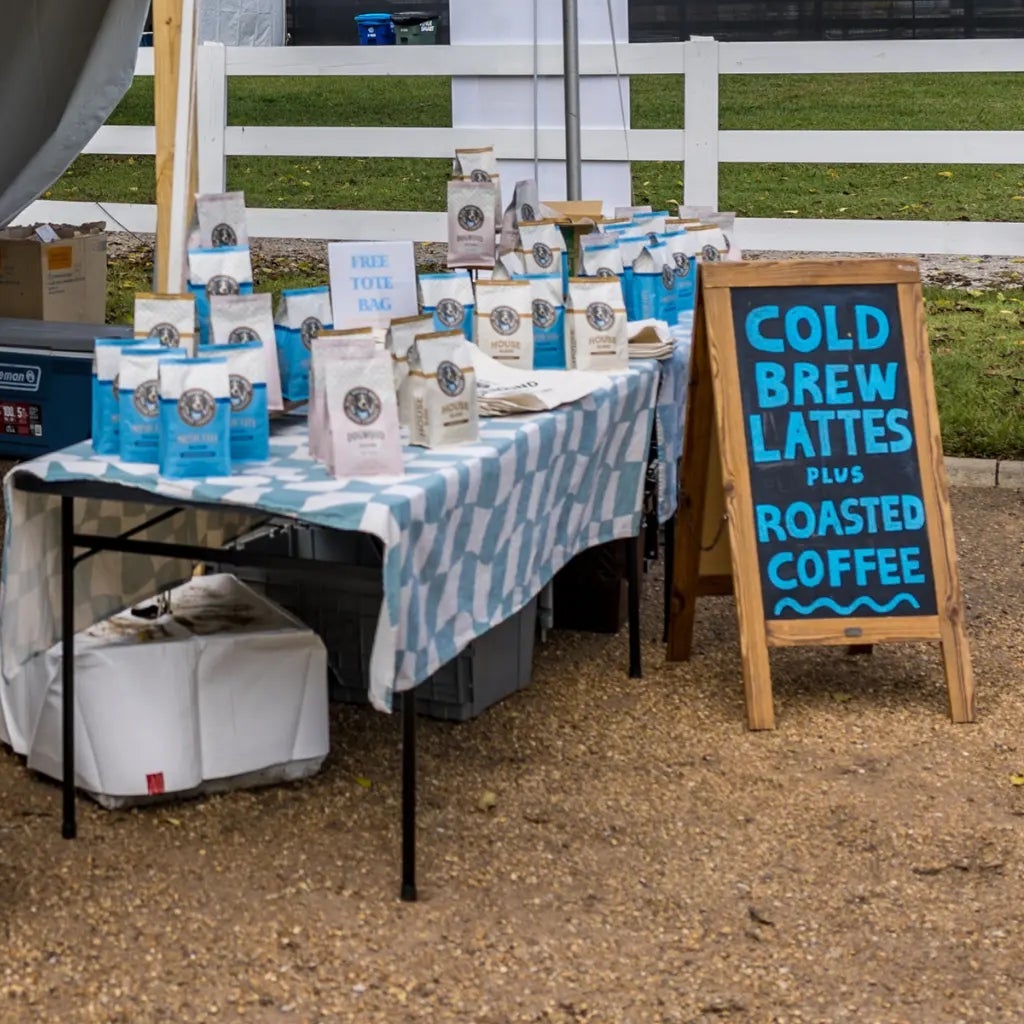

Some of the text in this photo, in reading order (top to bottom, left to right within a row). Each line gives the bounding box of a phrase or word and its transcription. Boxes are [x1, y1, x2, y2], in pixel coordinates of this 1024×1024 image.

[350, 254, 390, 269] FREE
[349, 275, 394, 290] TOTE
[358, 297, 392, 312] BAG
[490, 340, 521, 349] HOUSE
[744, 304, 891, 353] COLD
[754, 361, 898, 408] BREW
[749, 408, 913, 463] LATTES
[806, 465, 865, 487] PLUS
[755, 494, 926, 543] ROASTED
[767, 547, 926, 591] COFFEE
